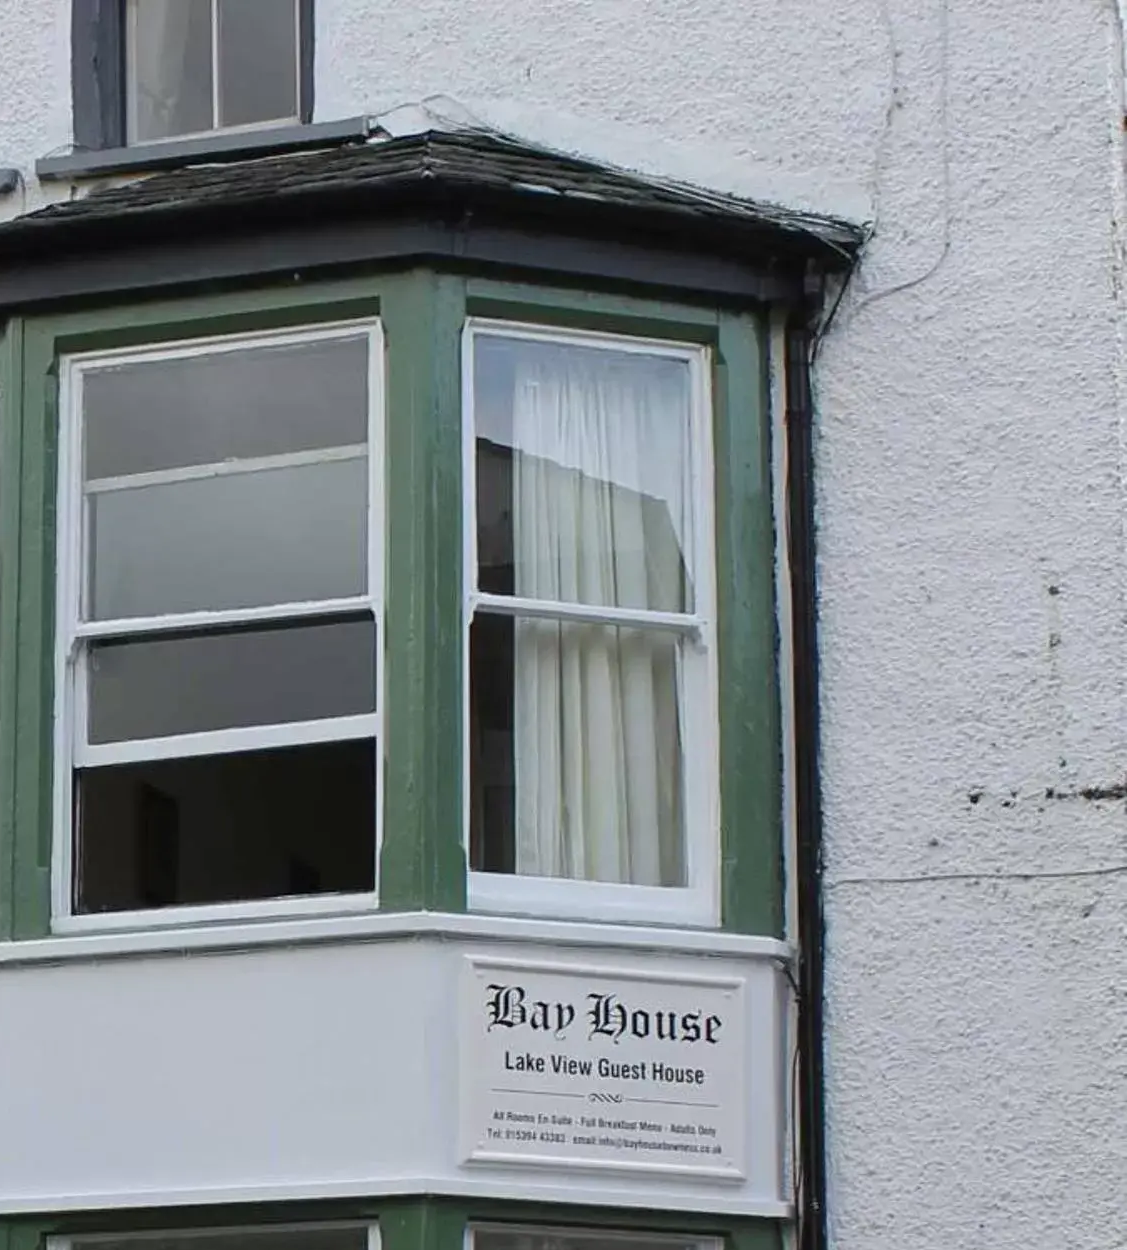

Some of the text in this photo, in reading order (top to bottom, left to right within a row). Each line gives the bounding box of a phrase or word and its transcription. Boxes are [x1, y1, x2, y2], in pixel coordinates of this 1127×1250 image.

[485, 984, 722, 1045] Bay House
[505, 1051, 705, 1085] Lake View Guest House
[506, 1112, 535, 1123] Rooms
